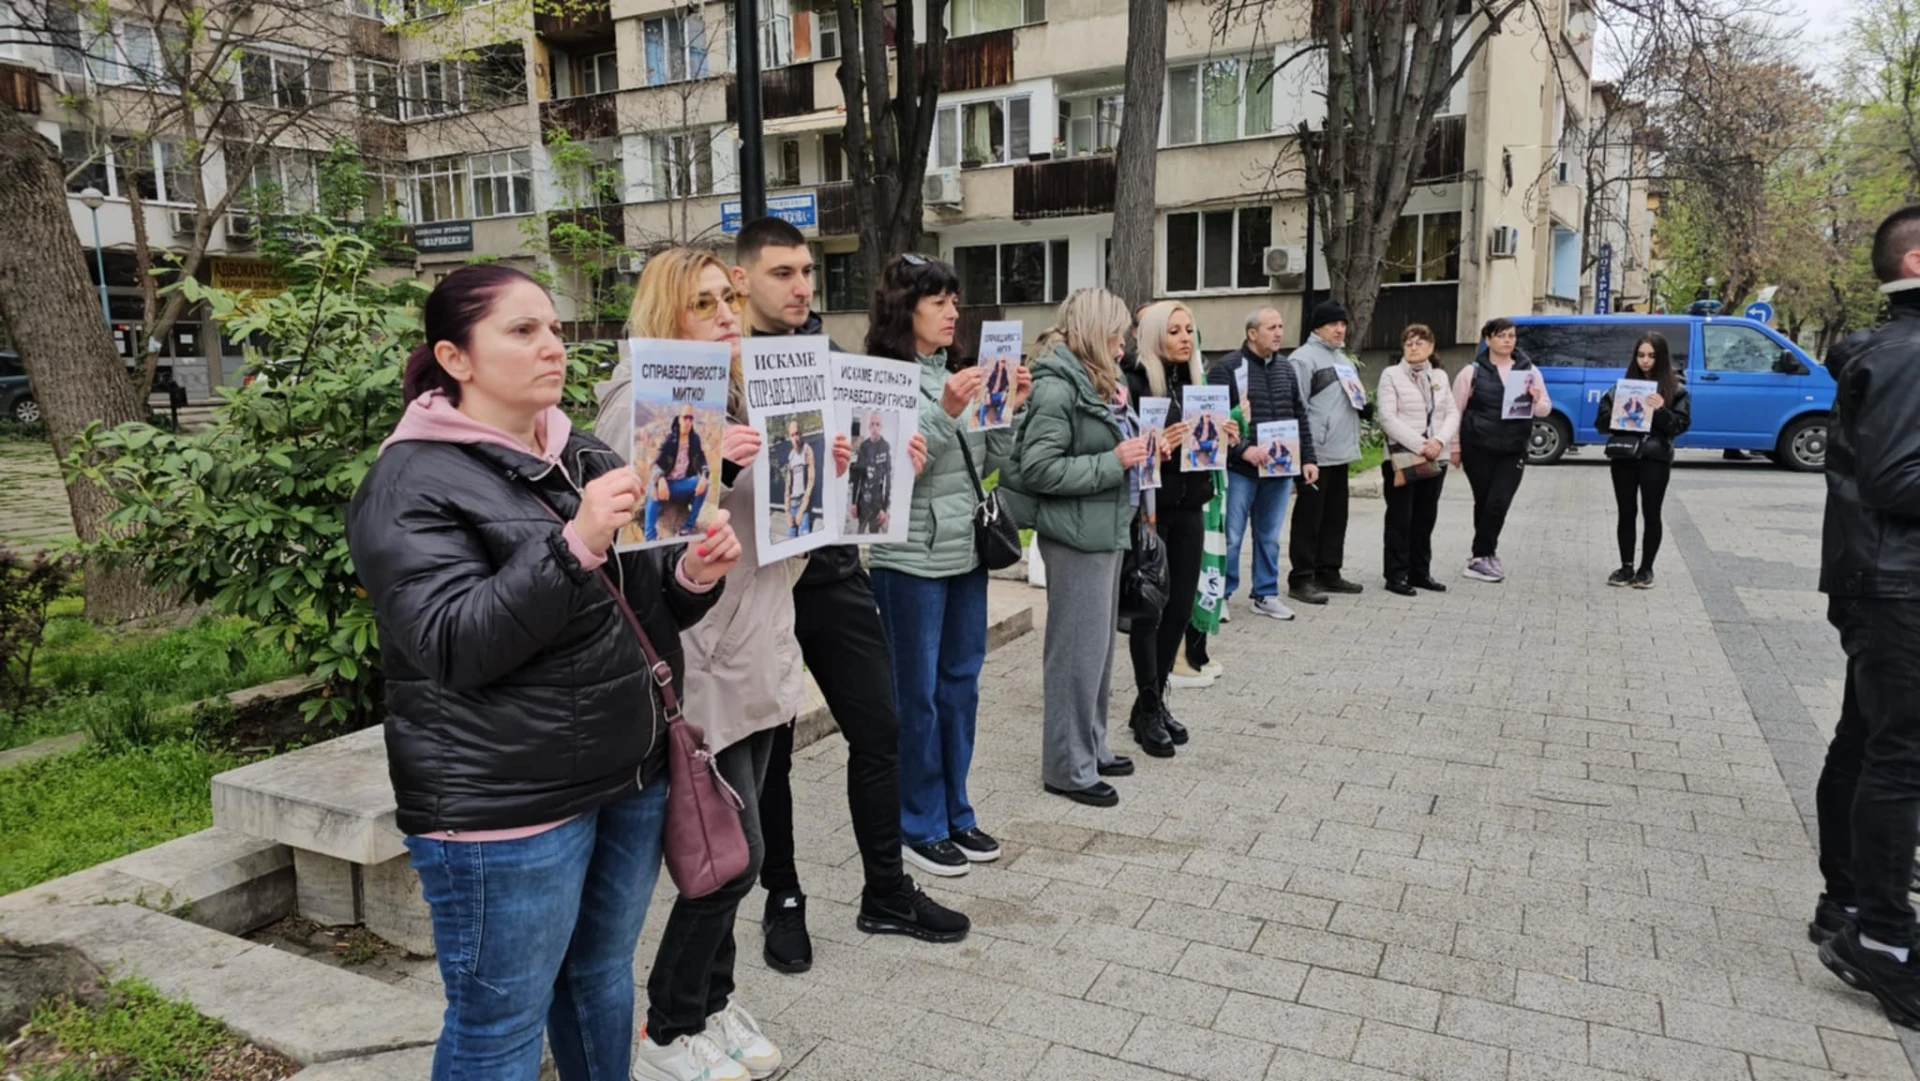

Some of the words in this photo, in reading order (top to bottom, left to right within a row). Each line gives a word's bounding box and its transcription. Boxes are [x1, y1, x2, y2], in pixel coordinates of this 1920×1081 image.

[754, 352, 817, 371] ИСКАМЕ
[642, 363, 718, 382] СПРАВЕДЛИВОСТ
[841, 365, 873, 383] ИСКАМЕ
[748, 374, 826, 409] СПРАВЕДЛИВОСТ
